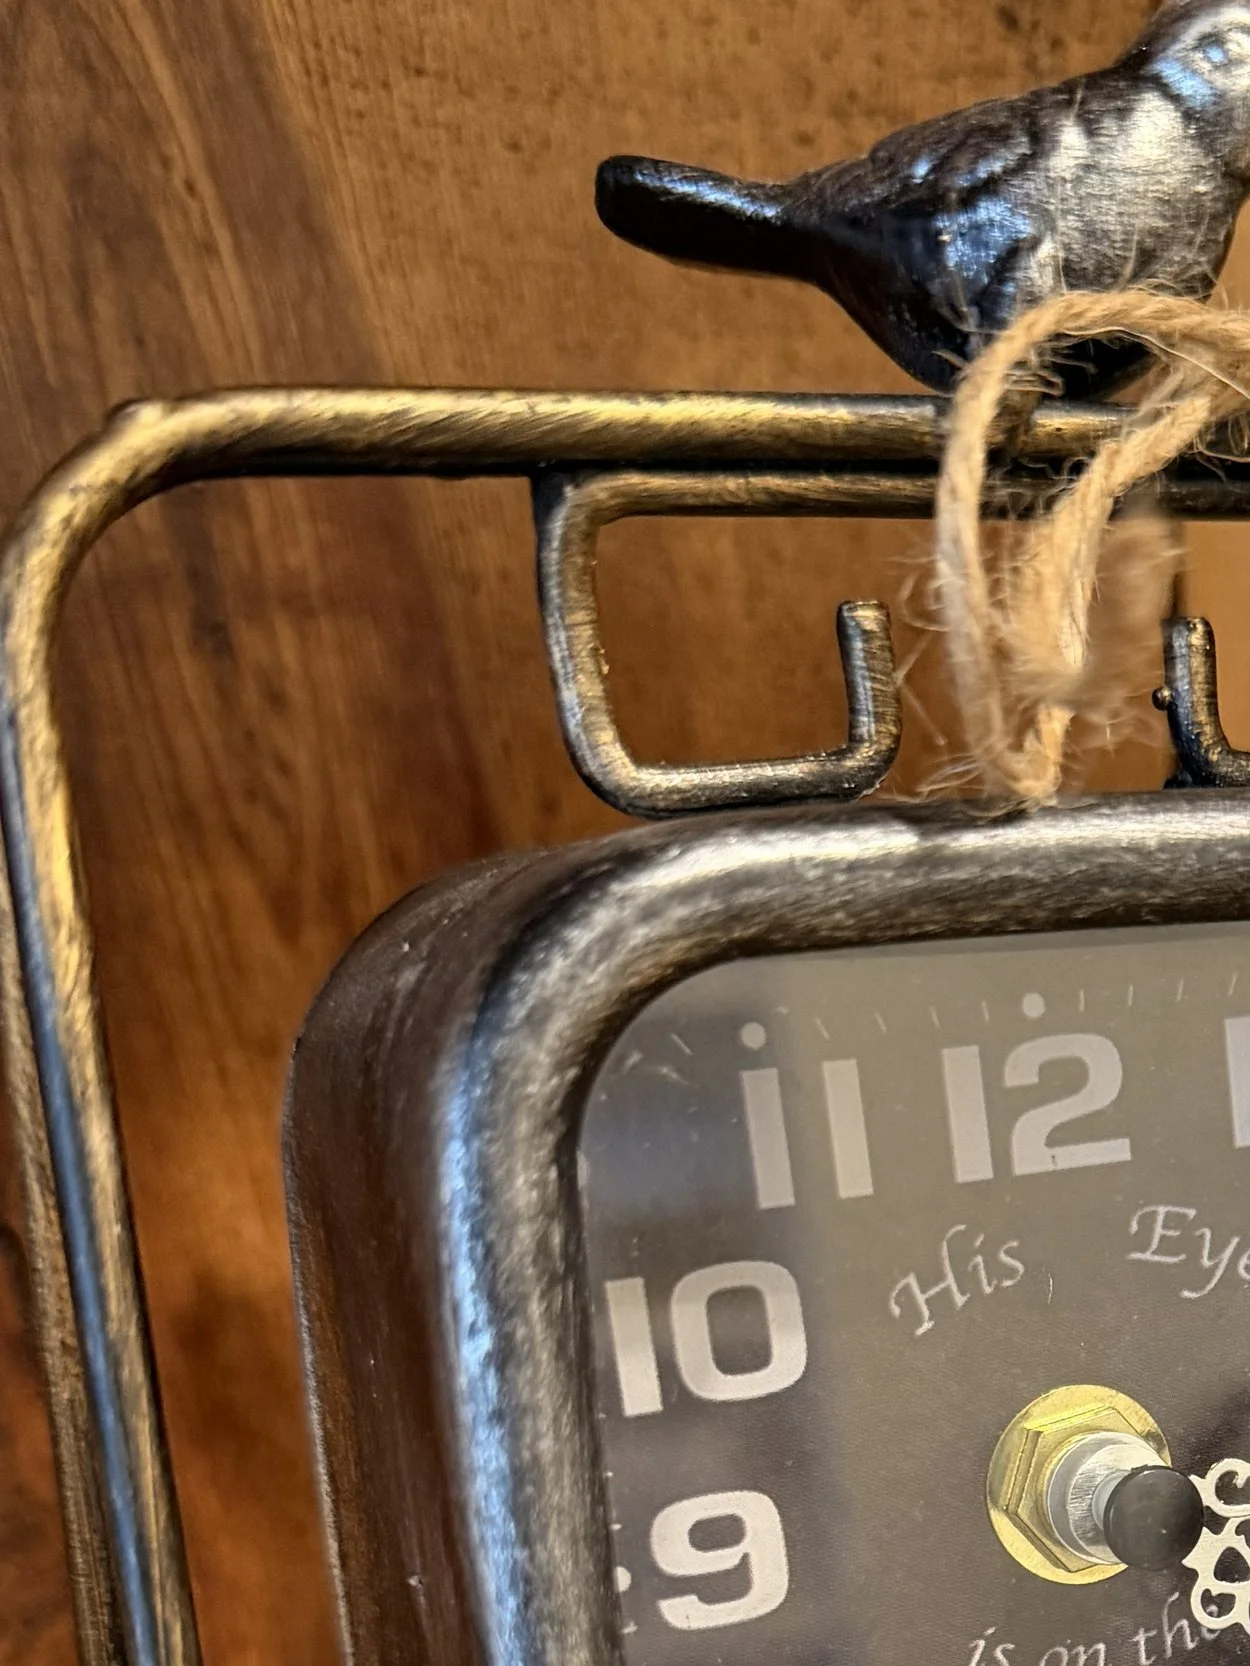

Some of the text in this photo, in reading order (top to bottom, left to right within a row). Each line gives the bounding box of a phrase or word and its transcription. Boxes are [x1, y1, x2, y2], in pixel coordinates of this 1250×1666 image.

[740, 1057, 874, 1211] 11
[941, 1032, 1133, 1185] 12
[604, 1259, 808, 1419] 10
[887, 1223, 1027, 1337] His
[649, 1489, 790, 1631] 9
